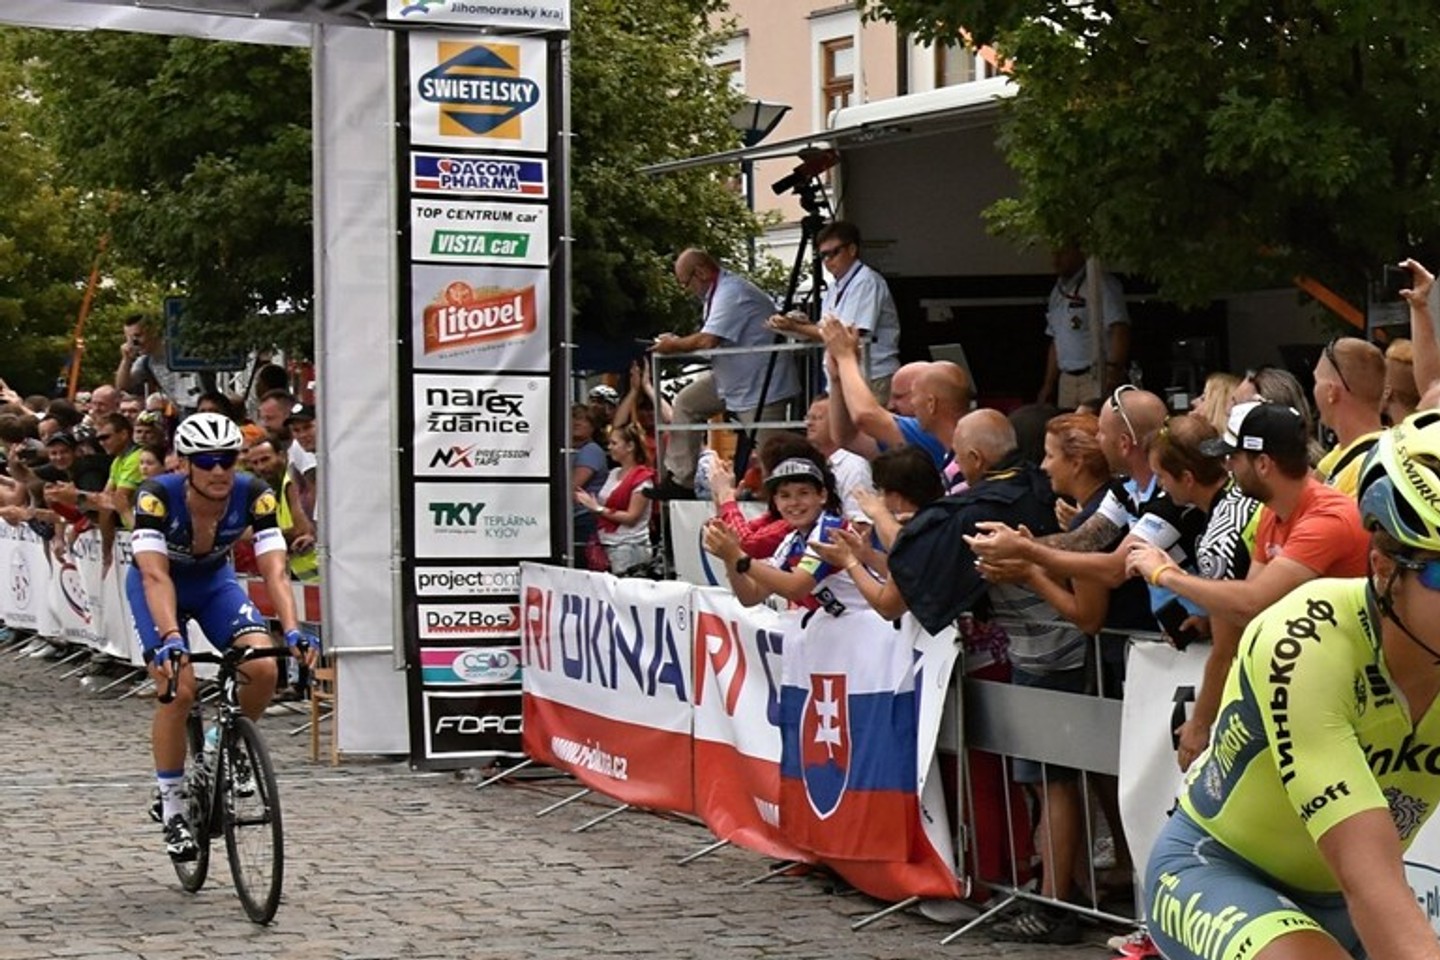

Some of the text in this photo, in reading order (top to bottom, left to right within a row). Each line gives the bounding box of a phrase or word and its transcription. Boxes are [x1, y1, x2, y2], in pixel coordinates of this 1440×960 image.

[539, 8, 565, 21] kraj
[423, 77, 534, 103] SWIETELSKY
[450, 161, 516, 177] DACOM
[441, 175, 519, 191] PHARMA
[417, 206, 538, 223] TOP CENTRUM car
[437, 233, 520, 254] VISTA car
[438, 295, 524, 343] Litovel
[426, 388, 523, 417] narex
[429, 503, 486, 526] TKY
[559, 593, 688, 703] OKNA
[435, 715, 523, 734] FORC
